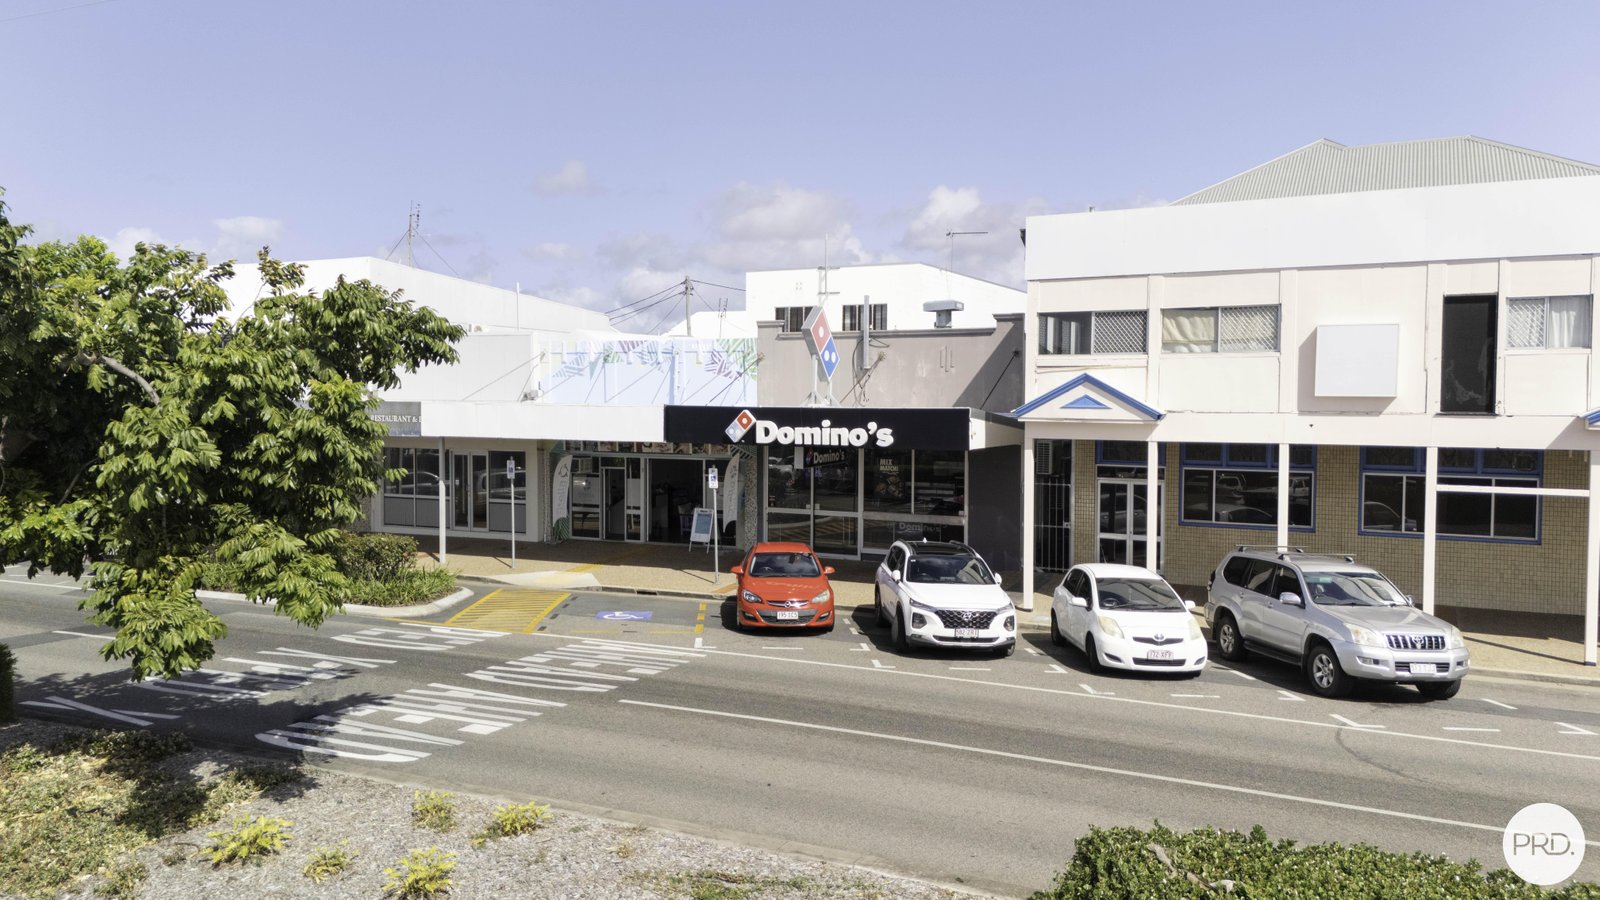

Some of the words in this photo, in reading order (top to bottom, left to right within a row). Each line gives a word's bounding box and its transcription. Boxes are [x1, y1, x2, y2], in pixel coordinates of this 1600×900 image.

[756, 419, 894, 447] Domino's
[813, 450, 845, 464] Domino's
[331, 623, 512, 650] PED
[256, 646, 397, 669] X
[465, 640, 707, 692] AHEAD
[254, 683, 568, 763] AHEAD
